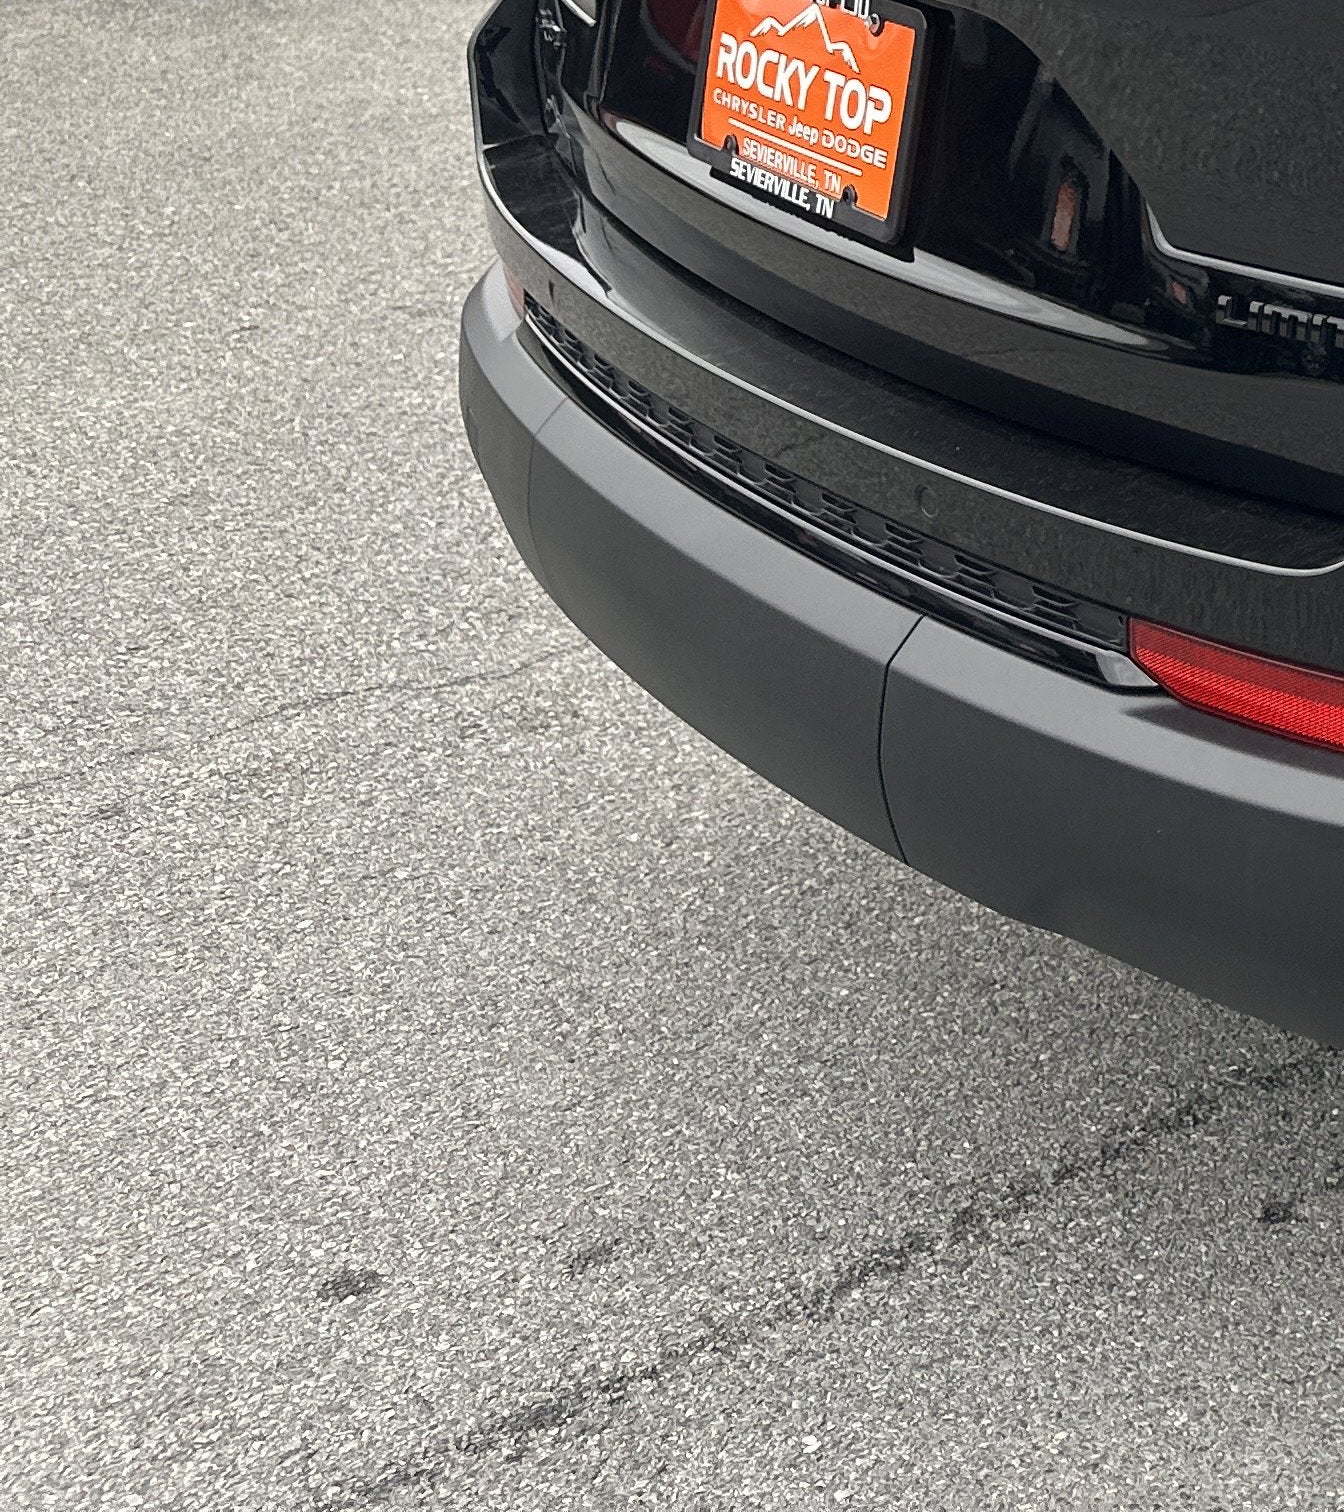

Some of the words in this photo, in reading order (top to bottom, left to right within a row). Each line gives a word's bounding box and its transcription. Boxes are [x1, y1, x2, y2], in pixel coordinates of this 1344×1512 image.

[715, 32, 820, 111] ROCKY
[822, 69, 893, 135] TOP
[712, 88, 786, 130] CHRYSLER
[788, 116, 820, 145] Jeep
[821, 128, 889, 169] DODGE
[742, 135, 820, 189] SEVIERVILLE,
[823, 169, 843, 193] TN
[729, 157, 812, 211] SEVIERVILLE,
[815, 193, 836, 220] TN
